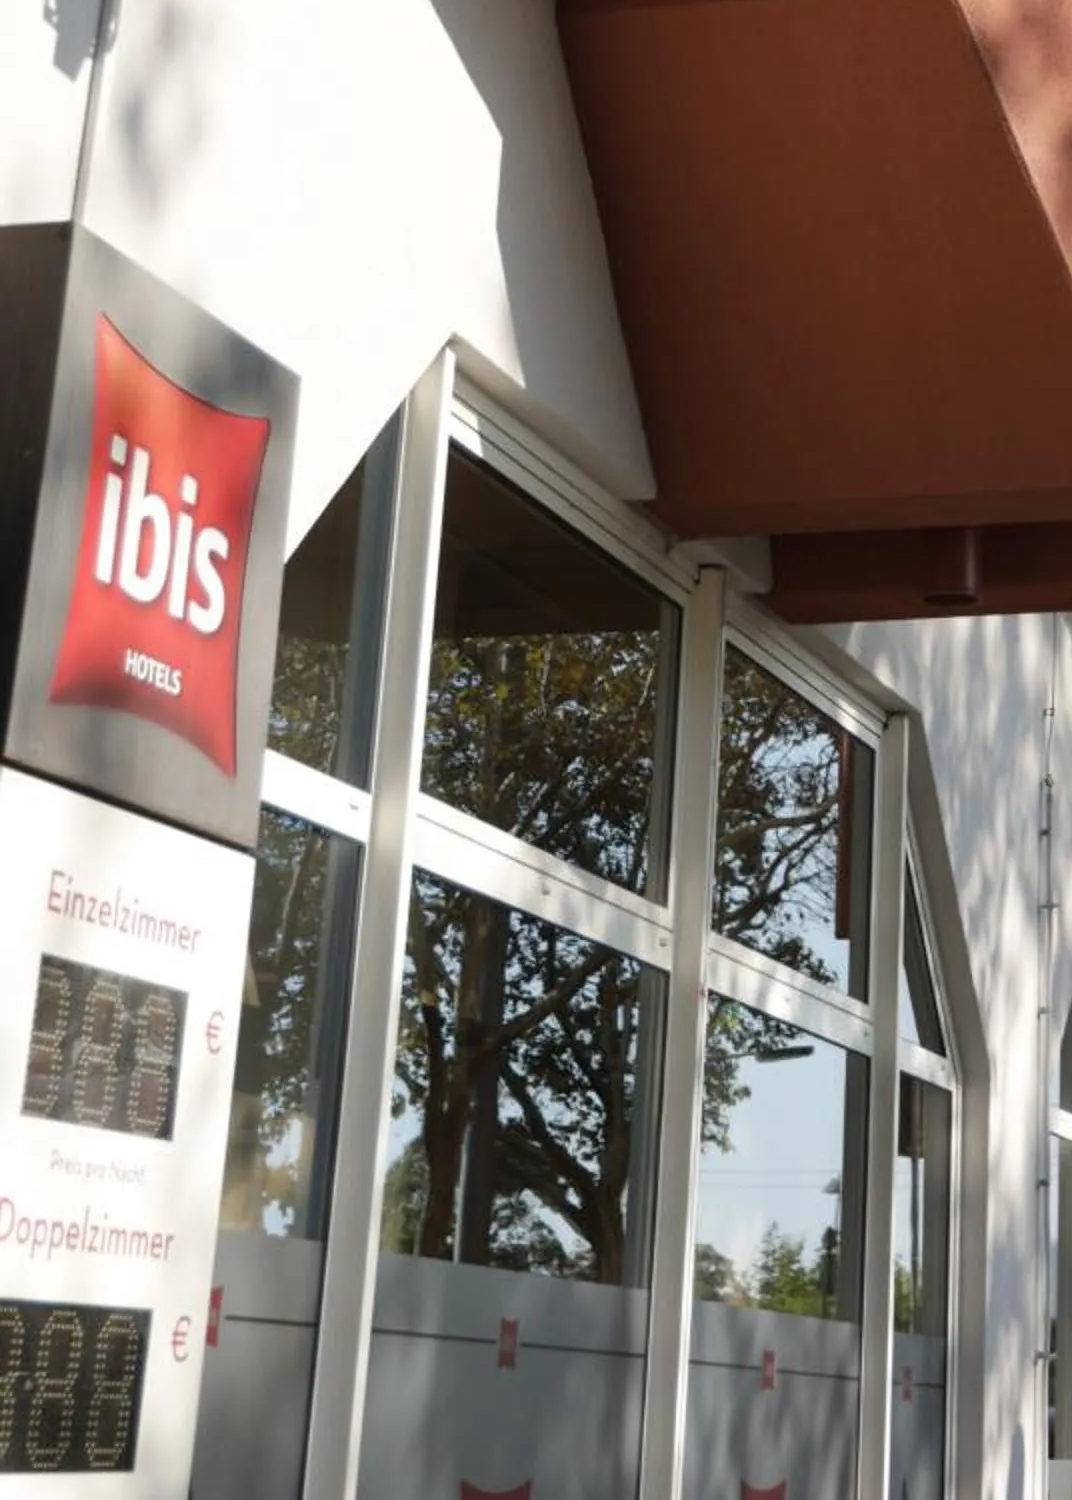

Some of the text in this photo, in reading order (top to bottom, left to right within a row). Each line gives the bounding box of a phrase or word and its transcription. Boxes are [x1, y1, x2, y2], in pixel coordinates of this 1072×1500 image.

[96, 434, 229, 635] ibis
[124, 648, 182, 696] HOTELS
[48, 869, 201, 953] Einzelzimmer
[206, 1010, 225, 1055] €
[0, 1197, 175, 1262] Doppelzimmer
[171, 1315, 192, 1363] €
